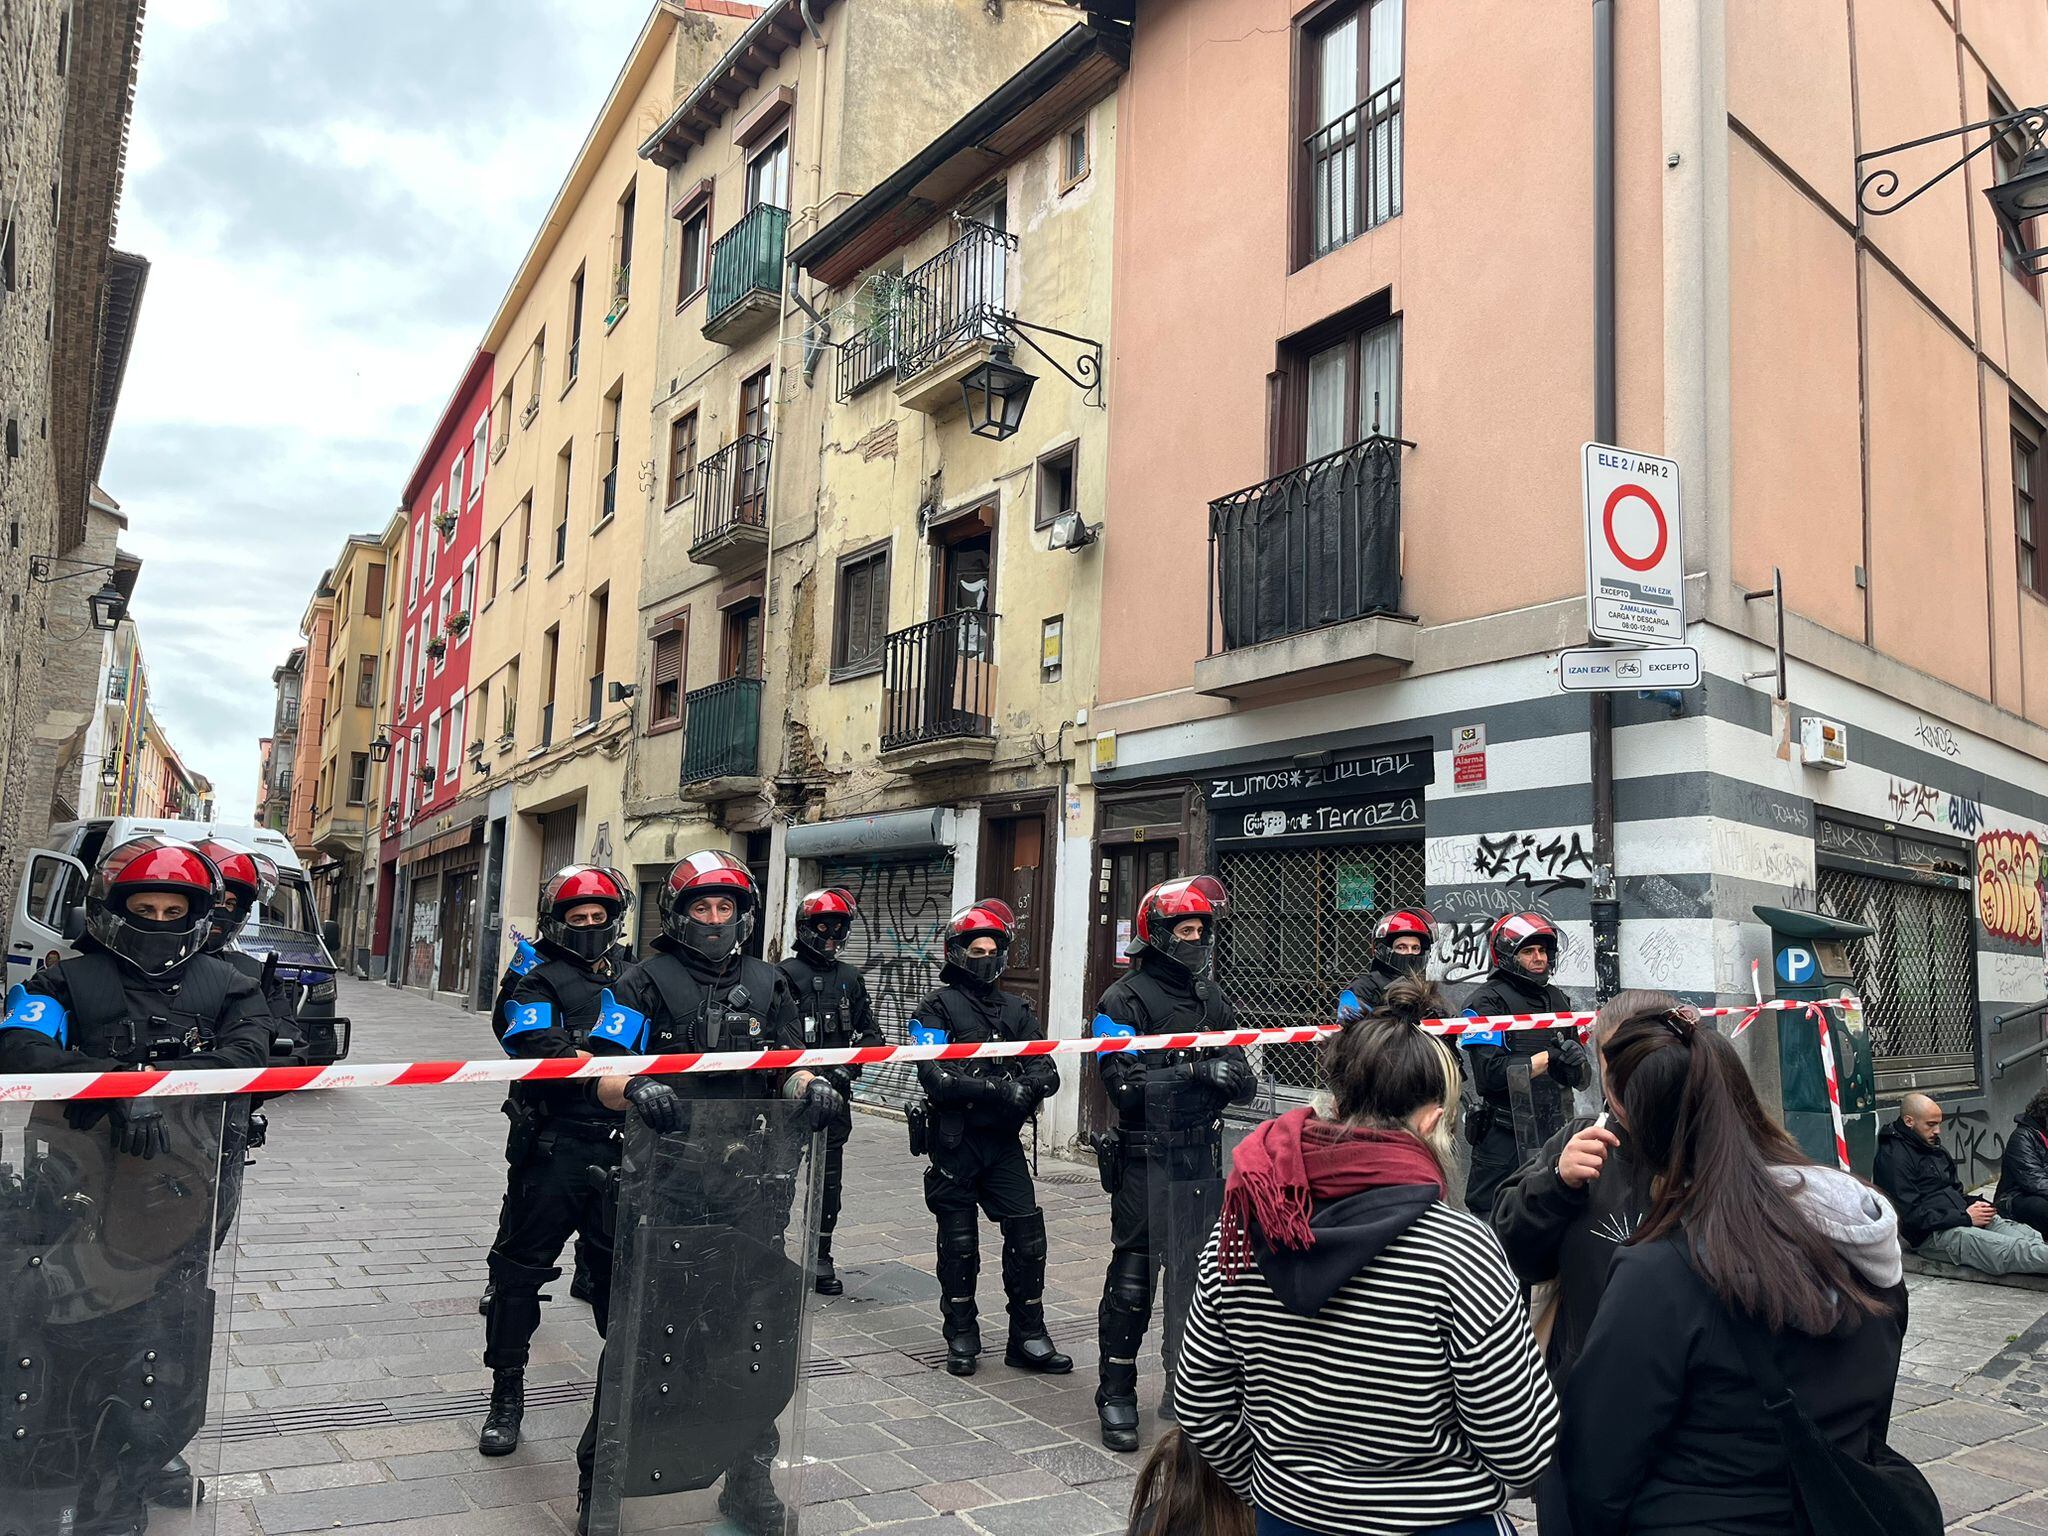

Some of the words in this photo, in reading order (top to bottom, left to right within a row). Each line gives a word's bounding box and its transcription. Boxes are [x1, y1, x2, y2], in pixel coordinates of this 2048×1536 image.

[1598, 453, 1619, 469] ELE
[1621, 457, 1628, 470] 2
[1637, 461, 1660, 477] APR
[1661, 466, 1668, 479] 2
[1600, 586, 1630, 598] EXCEPTO
[1642, 584, 1657, 594] IZAN
[1658, 586, 1672, 596] EZIK
[1620, 603, 1658, 616] ZAMALANAK
[1608, 610, 1631, 621] CARGA
[1631, 614, 1637, 622] Y
[1636, 615, 1670, 627] DESCARGA
[1621, 621, 1655, 633] 08:00-12:00
[1568, 666, 1589, 675] IZAN
[1590, 665, 1611, 674] EZIK
[1648, 663, 1690, 672] EXCEPTO
[1455, 755, 1484, 766] Alarma
[1316, 798, 1419, 831] Terraza
[1135, 829, 1143, 839] 65
[1787, 948, 1811, 981] P
[19, 1001, 46, 1023] 3
[522, 1008, 538, 1025] 3
[605, 1012, 626, 1035] 3
[922, 1032, 935, 1046] 3
